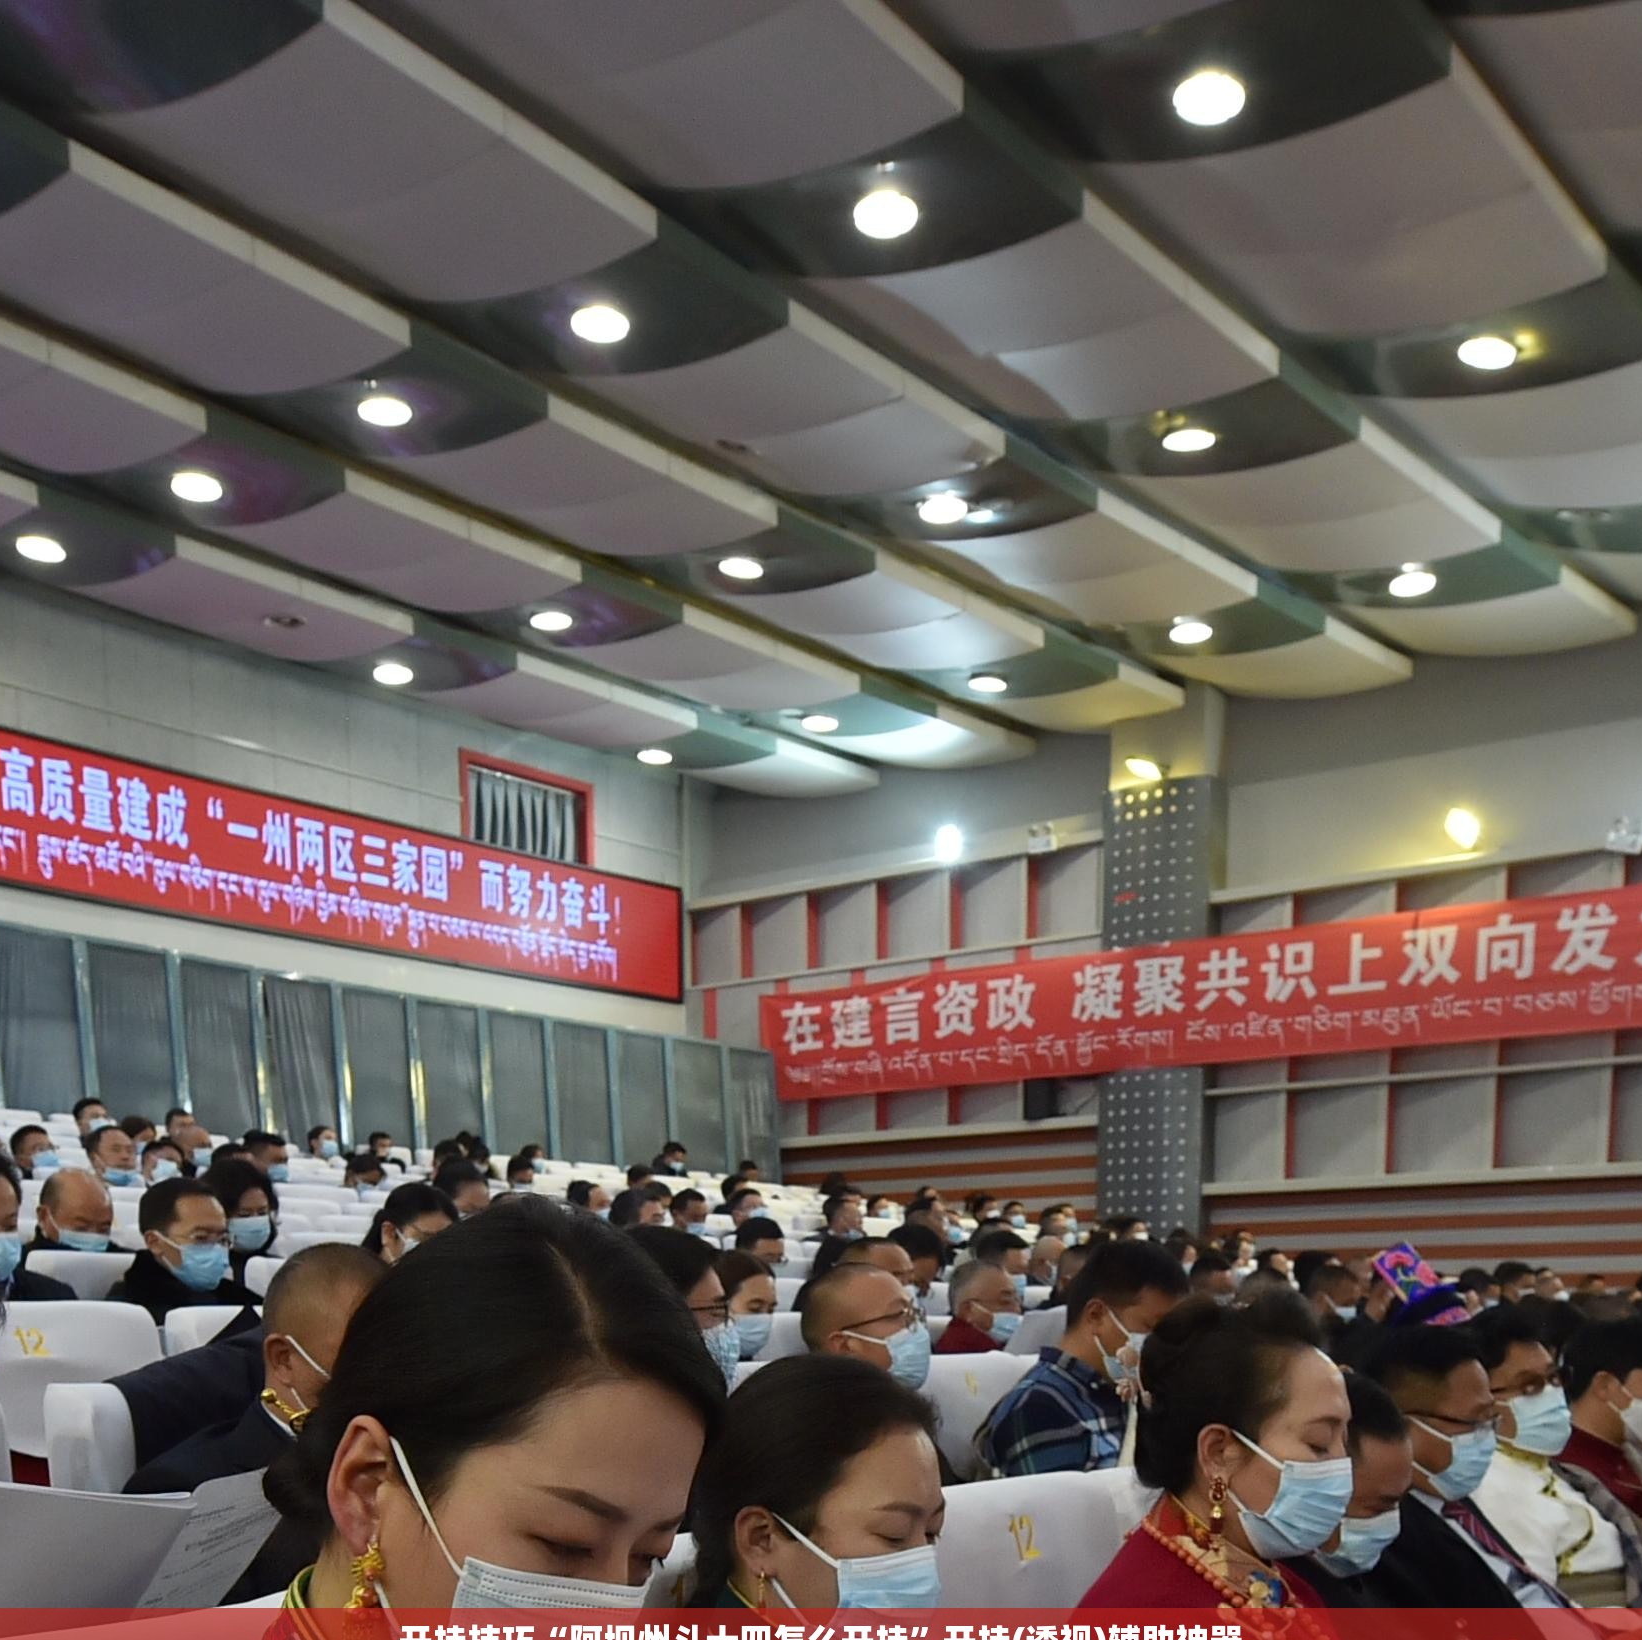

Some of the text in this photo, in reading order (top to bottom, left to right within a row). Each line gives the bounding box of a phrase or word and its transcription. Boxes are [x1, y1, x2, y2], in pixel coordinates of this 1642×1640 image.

[780, 977, 1038, 1056] 在建言资政
[13, 1327, 51, 1357] 12
[1007, 1513, 1042, 1563] 12
